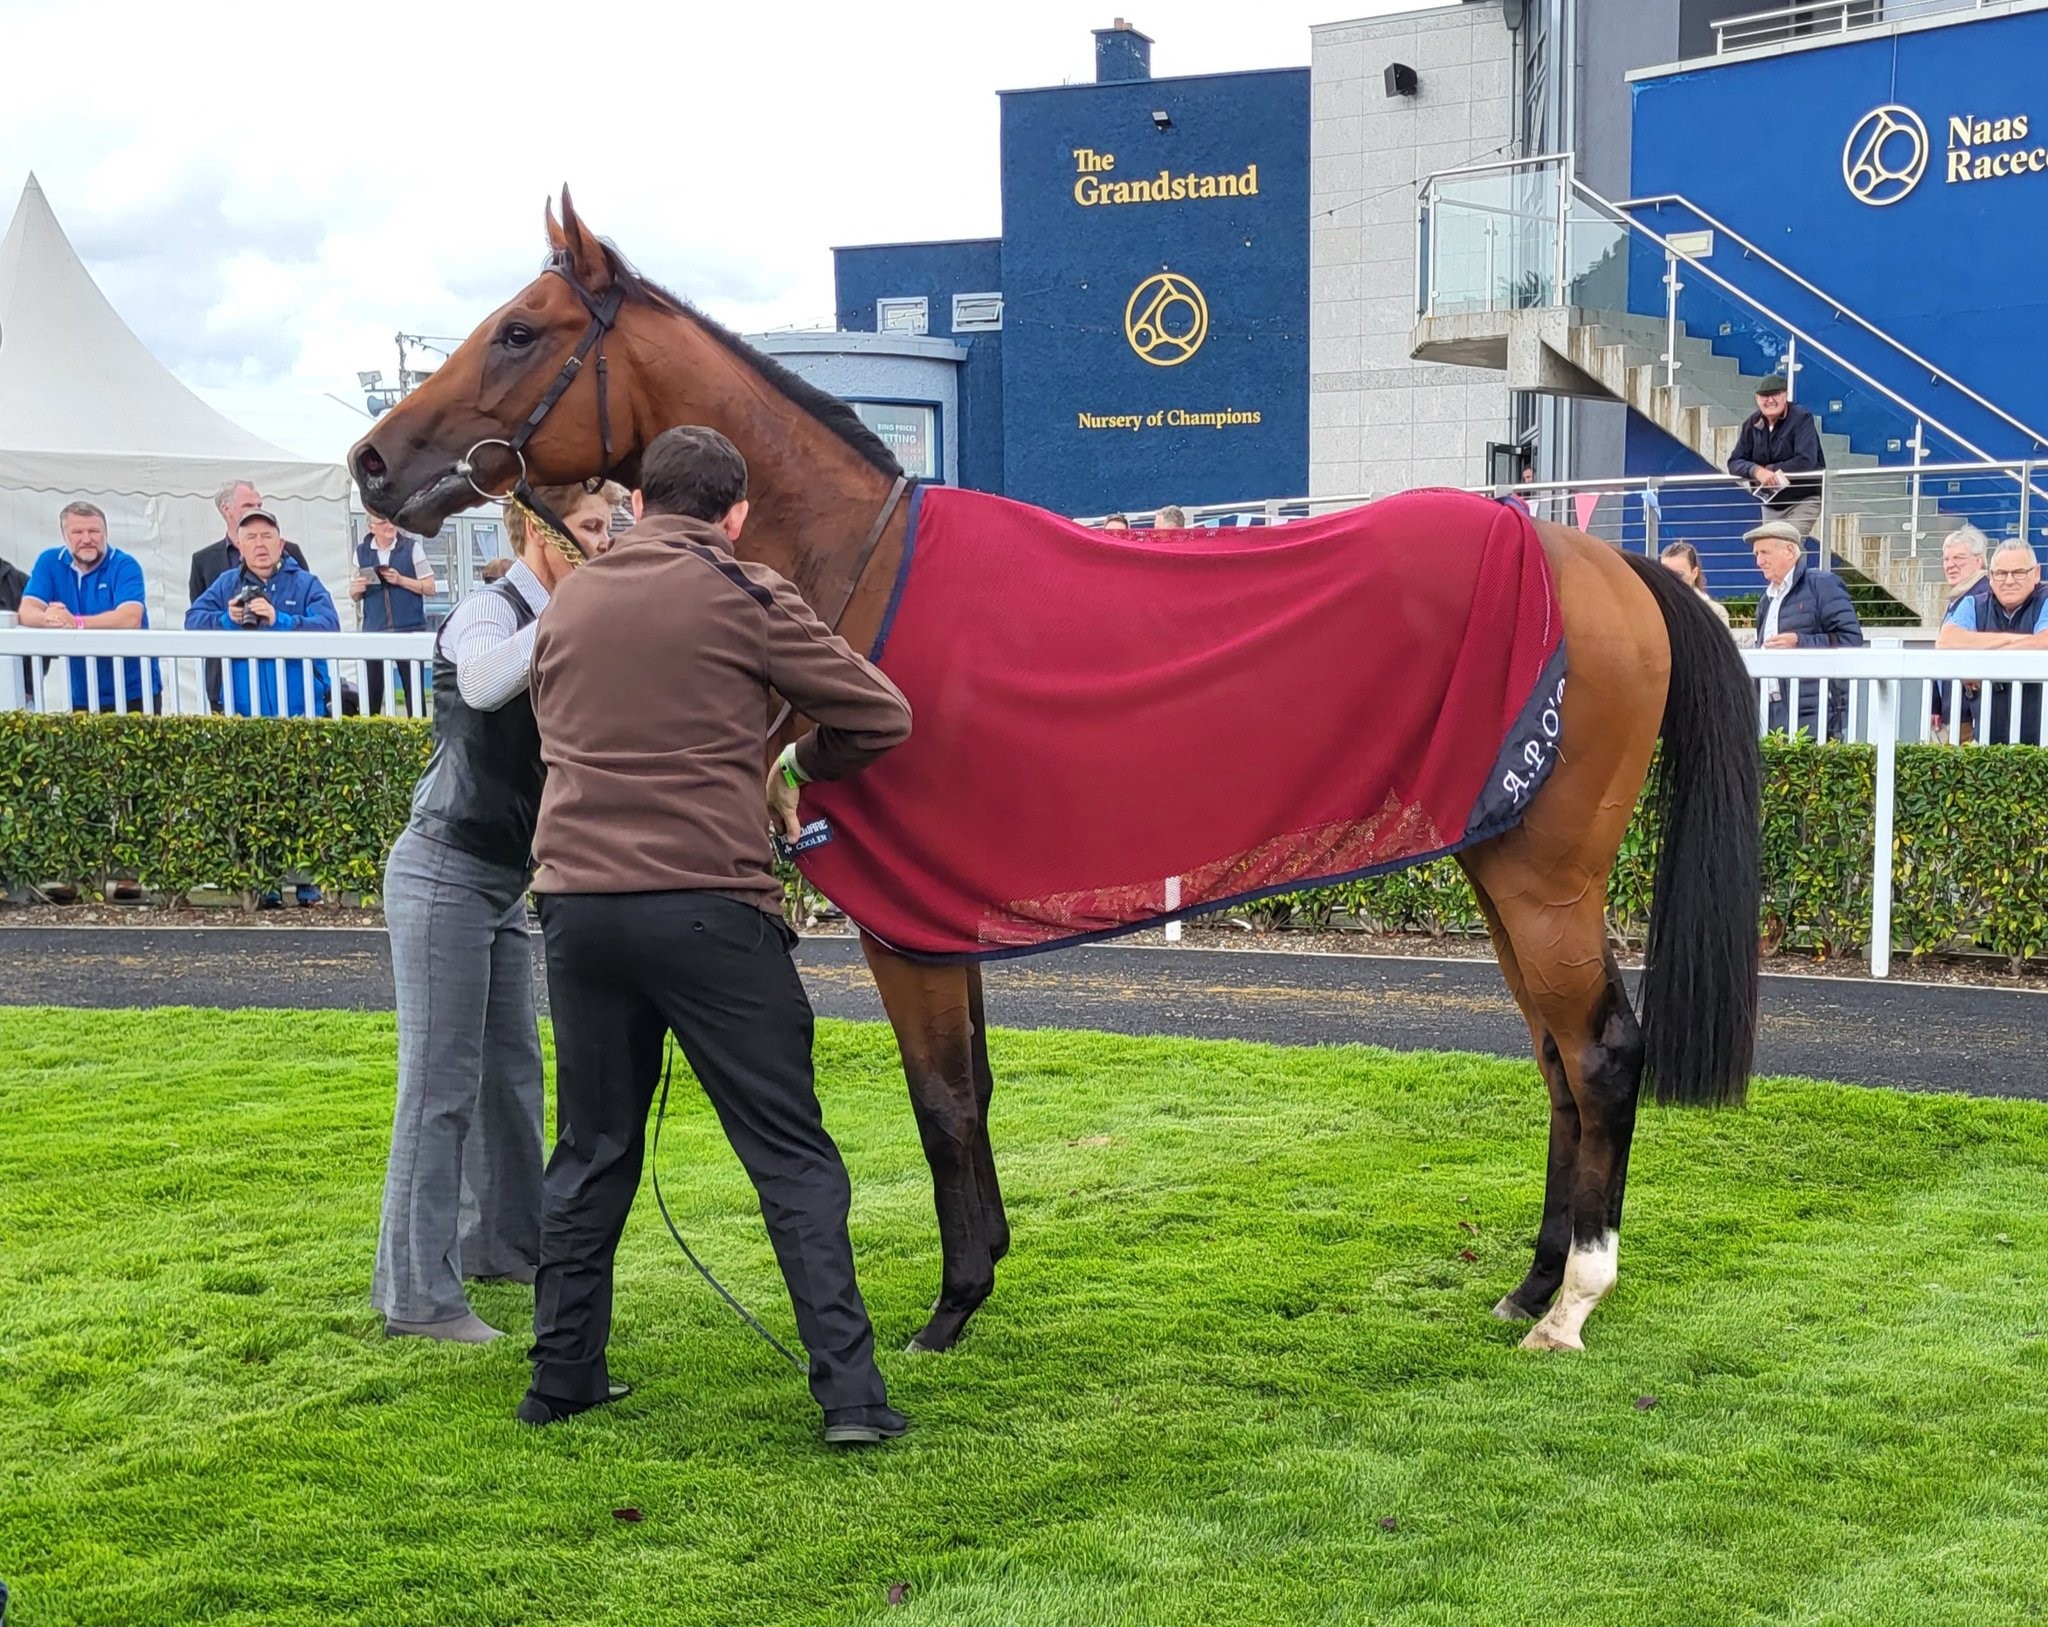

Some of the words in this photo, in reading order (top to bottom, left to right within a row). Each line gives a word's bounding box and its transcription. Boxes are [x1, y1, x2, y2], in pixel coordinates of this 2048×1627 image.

[1947, 114, 2028, 150] Naas
[1073, 149, 1114, 172] The
[1945, 147, 2048, 184] Racec
[1073, 164, 1259, 206] Grandstand
[1078, 411, 1142, 431] Nursery
[1146, 409, 1164, 427] of
[1167, 406, 1262, 429] Champions
[795, 834, 828, 851] COOLER
